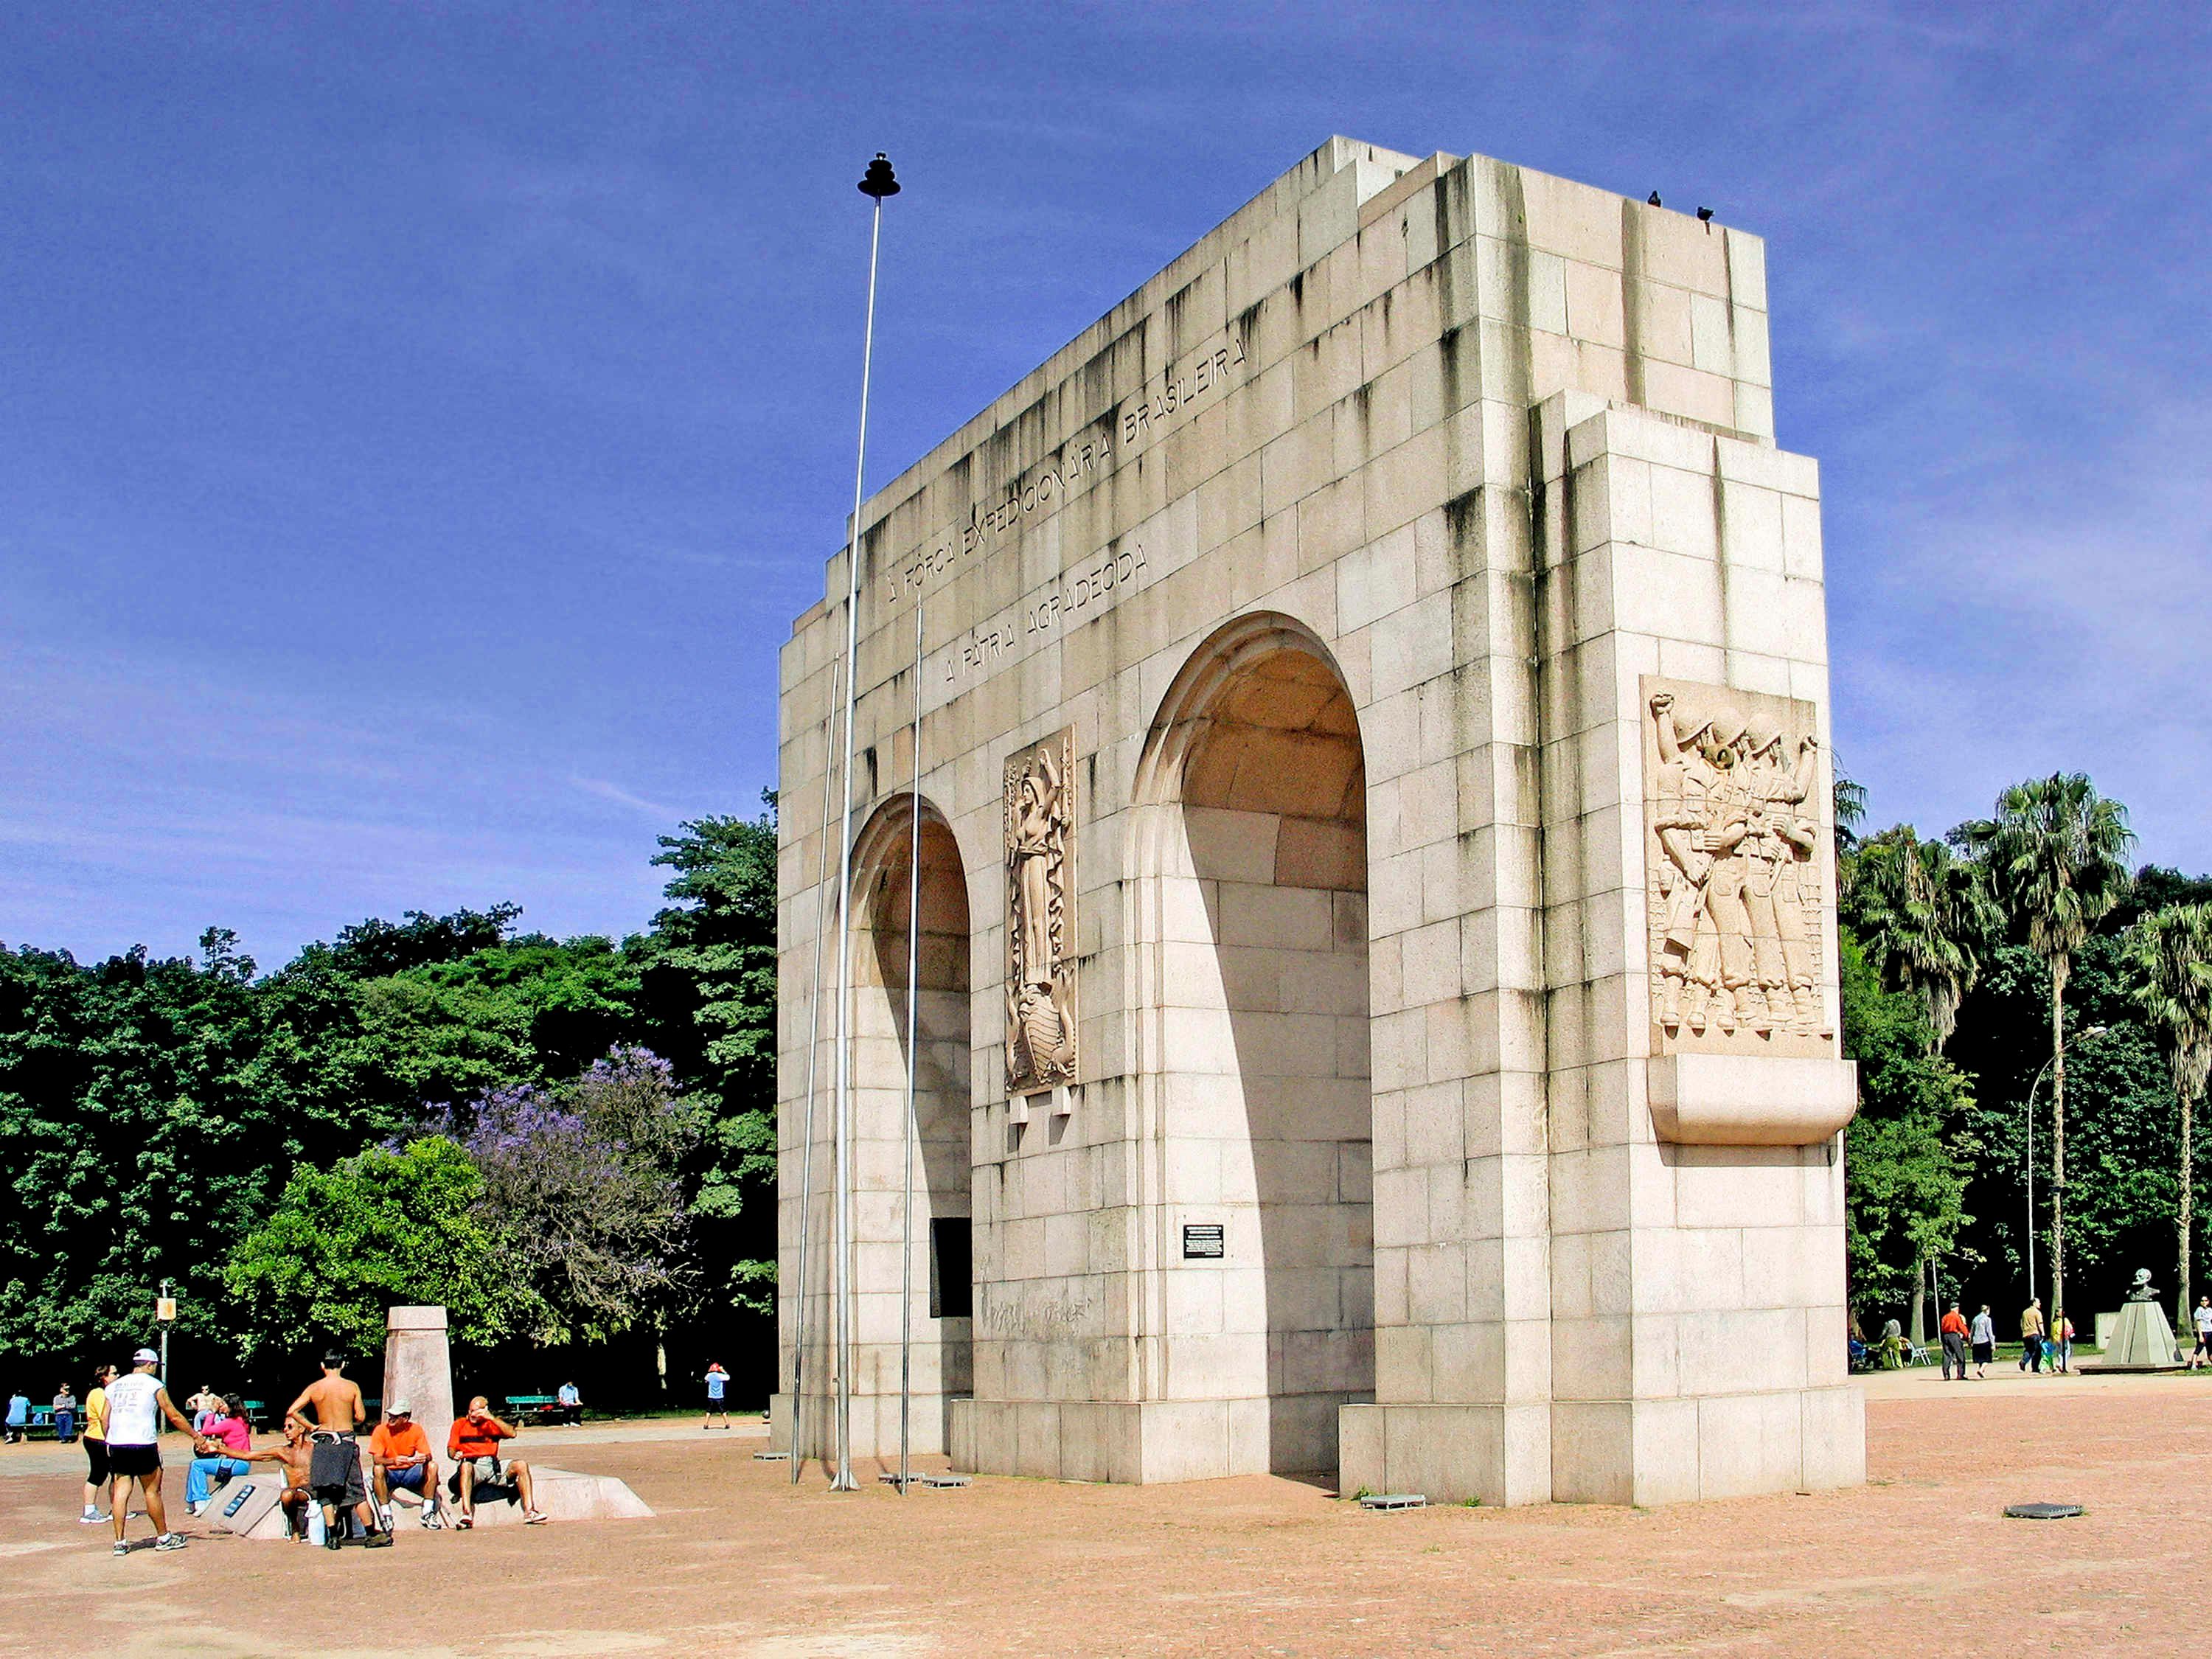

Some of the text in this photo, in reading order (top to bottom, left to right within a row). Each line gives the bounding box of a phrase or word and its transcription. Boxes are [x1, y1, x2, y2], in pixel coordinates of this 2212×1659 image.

[962, 432, 1111, 556] EXPEDICIONÁRIA
[1123, 338, 1246, 446] BRASILEIRA
[946, 543, 1148, 684] A PÁTRIA AGRADECIDA
